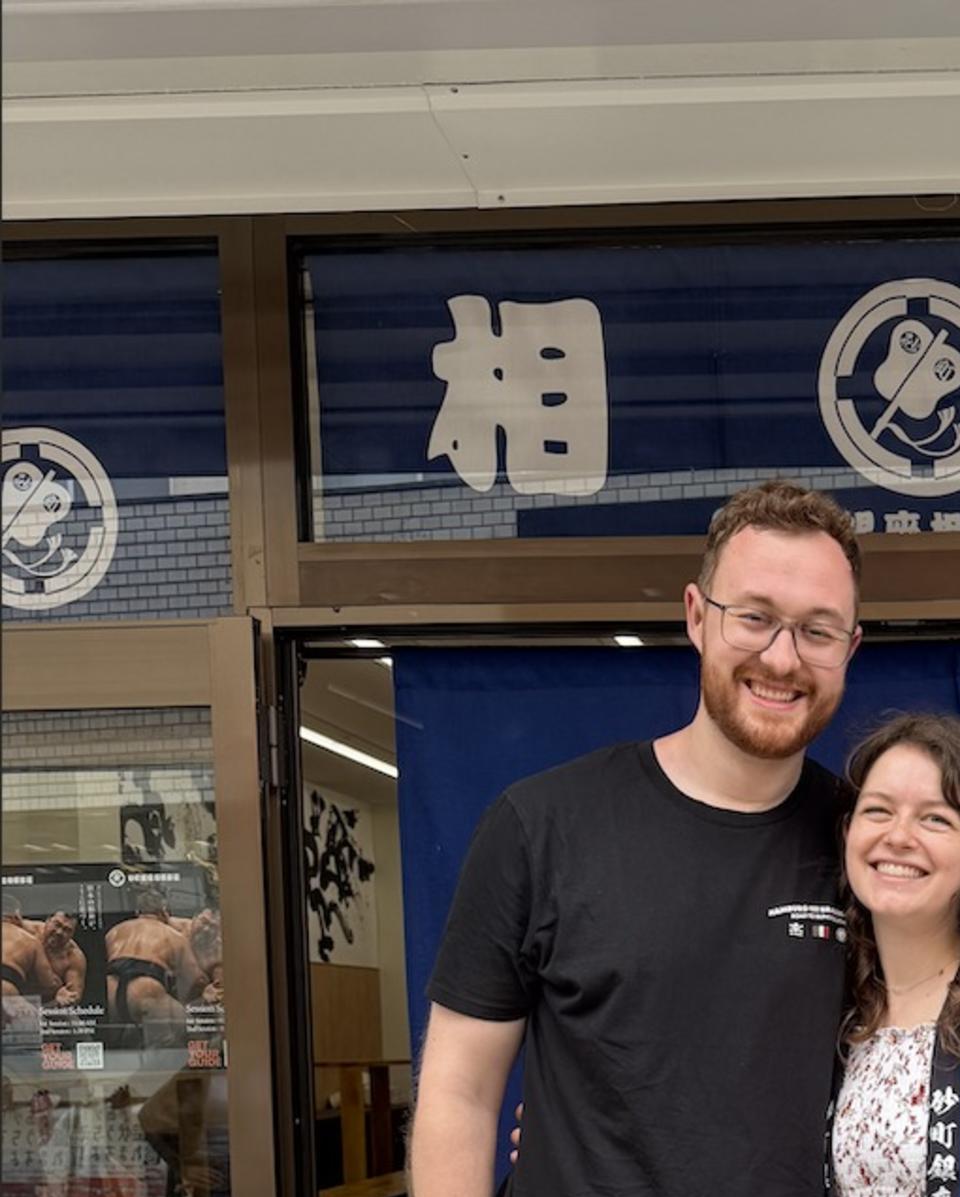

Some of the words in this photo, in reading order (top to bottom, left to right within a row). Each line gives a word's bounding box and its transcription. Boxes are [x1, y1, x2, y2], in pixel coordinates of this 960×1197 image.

[429, 295, 609, 497] 相
[41, 1043, 62, 1053] GET
[188, 1041, 208, 1051] GET
[42, 1051, 73, 1061] YOUR
[42, 1060, 75, 1070] GUIDE
